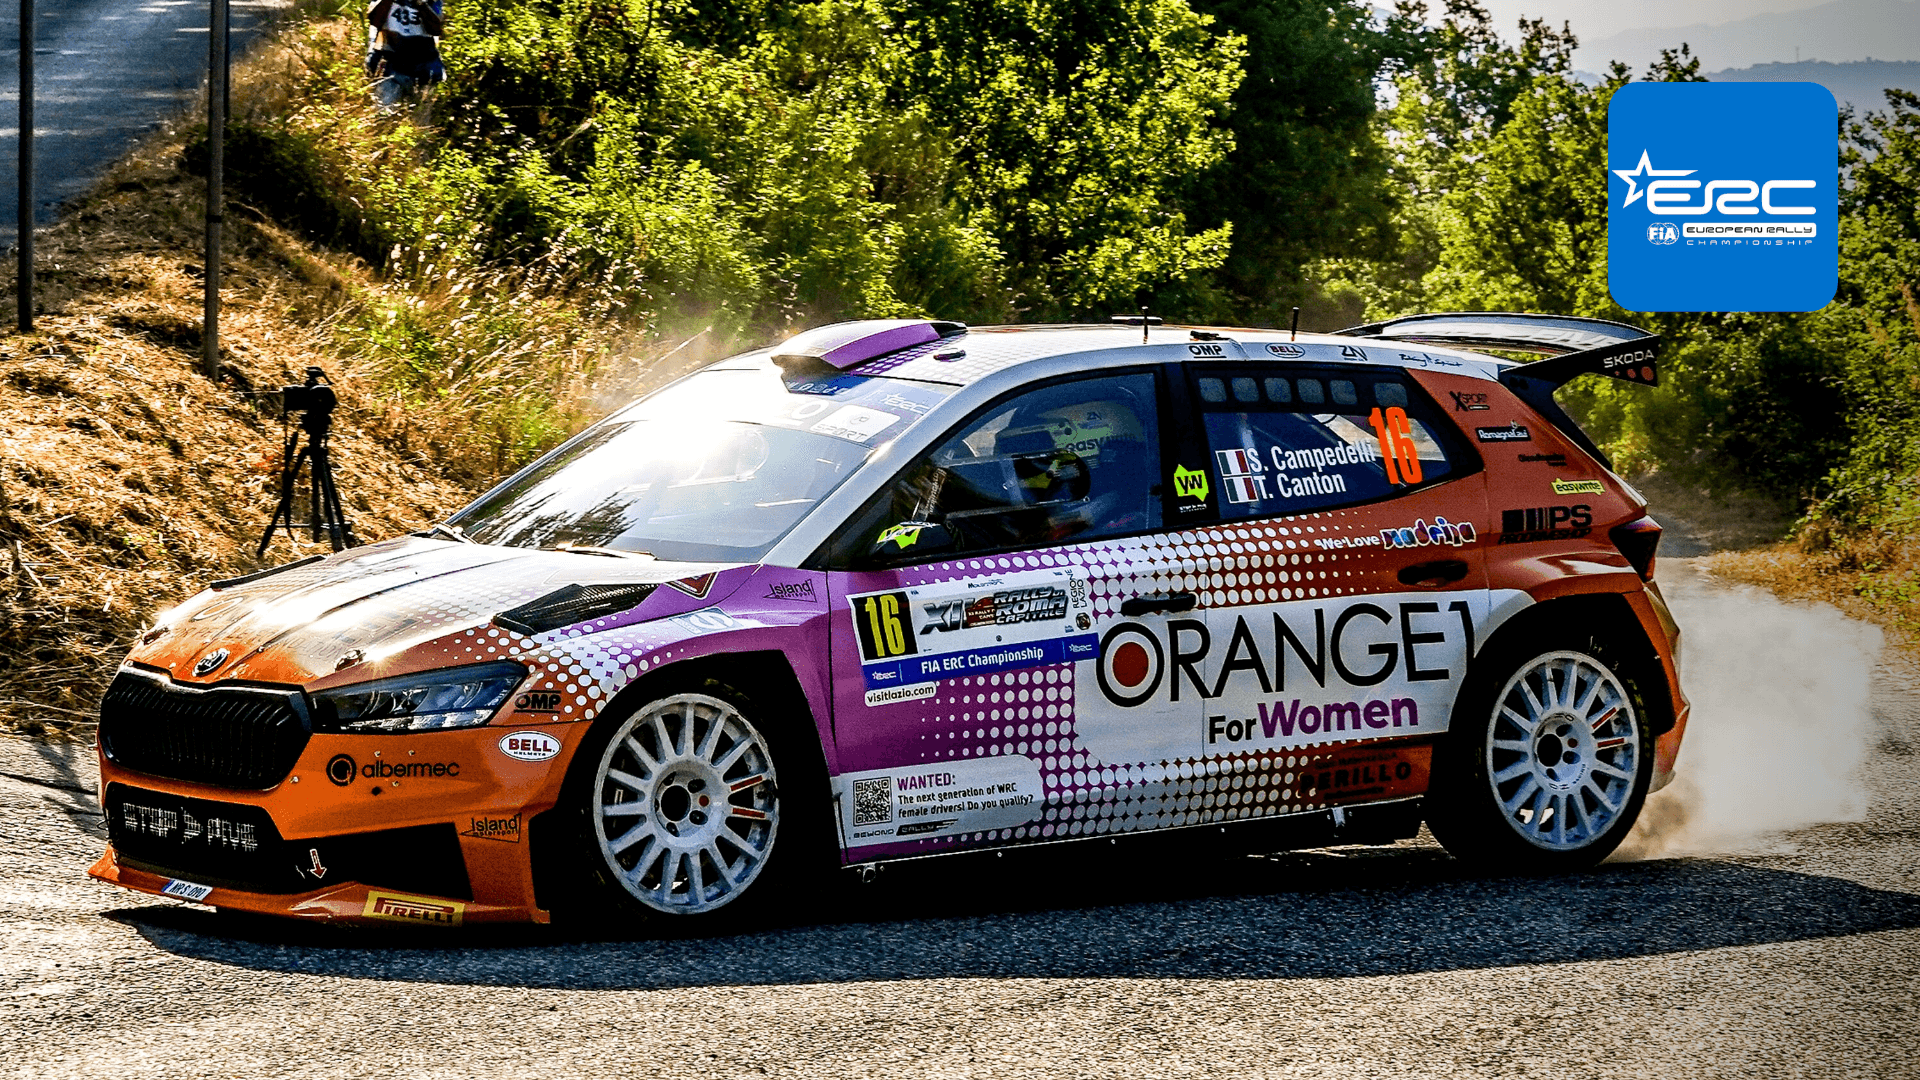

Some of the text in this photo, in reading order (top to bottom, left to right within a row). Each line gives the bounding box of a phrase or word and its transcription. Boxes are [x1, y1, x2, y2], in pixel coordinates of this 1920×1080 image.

[1189, 345, 1223, 356] OMP
[1269, 345, 1303, 354] BELL
[1603, 349, 1655, 369] SKODA
[1368, 406, 1423, 485] 16
[1247, 440, 1376, 474] S. Campedelli
[1253, 472, 1347, 500] T. Canton
[1550, 504, 1593, 529] PS
[769, 580, 813, 596] Island
[994, 586, 1054, 605] RALLY
[1065, 569, 1080, 609] REGIONE
[1076, 579, 1088, 608] LAZIO
[996, 597, 1067, 617] ROMA
[996, 609, 1064, 624] CAPITALE
[865, 594, 906, 656] 16
[920, 646, 1044, 674] FIA ERC Championship
[1095, 601, 1475, 708] ORANGE1
[515, 694, 562, 709] OMP
[867, 684, 935, 704] visitlazio.com
[1208, 697, 1418, 744] For Women
[508, 738, 552, 753] BELL
[361, 759, 460, 779] albermec
[1301, 761, 1411, 793] PERILLO
[897, 772, 956, 791] WANTED:
[898, 782, 1018, 805] The next generation of WRC
[898, 806, 928, 818] female
[967, 800, 979, 811] Do
[981, 798, 998, 811] you
[999, 794, 1034, 809] qualify?
[471, 815, 518, 832] Island
[853, 829, 895, 838] BEYOND
[373, 896, 455, 925] PIRELLI
